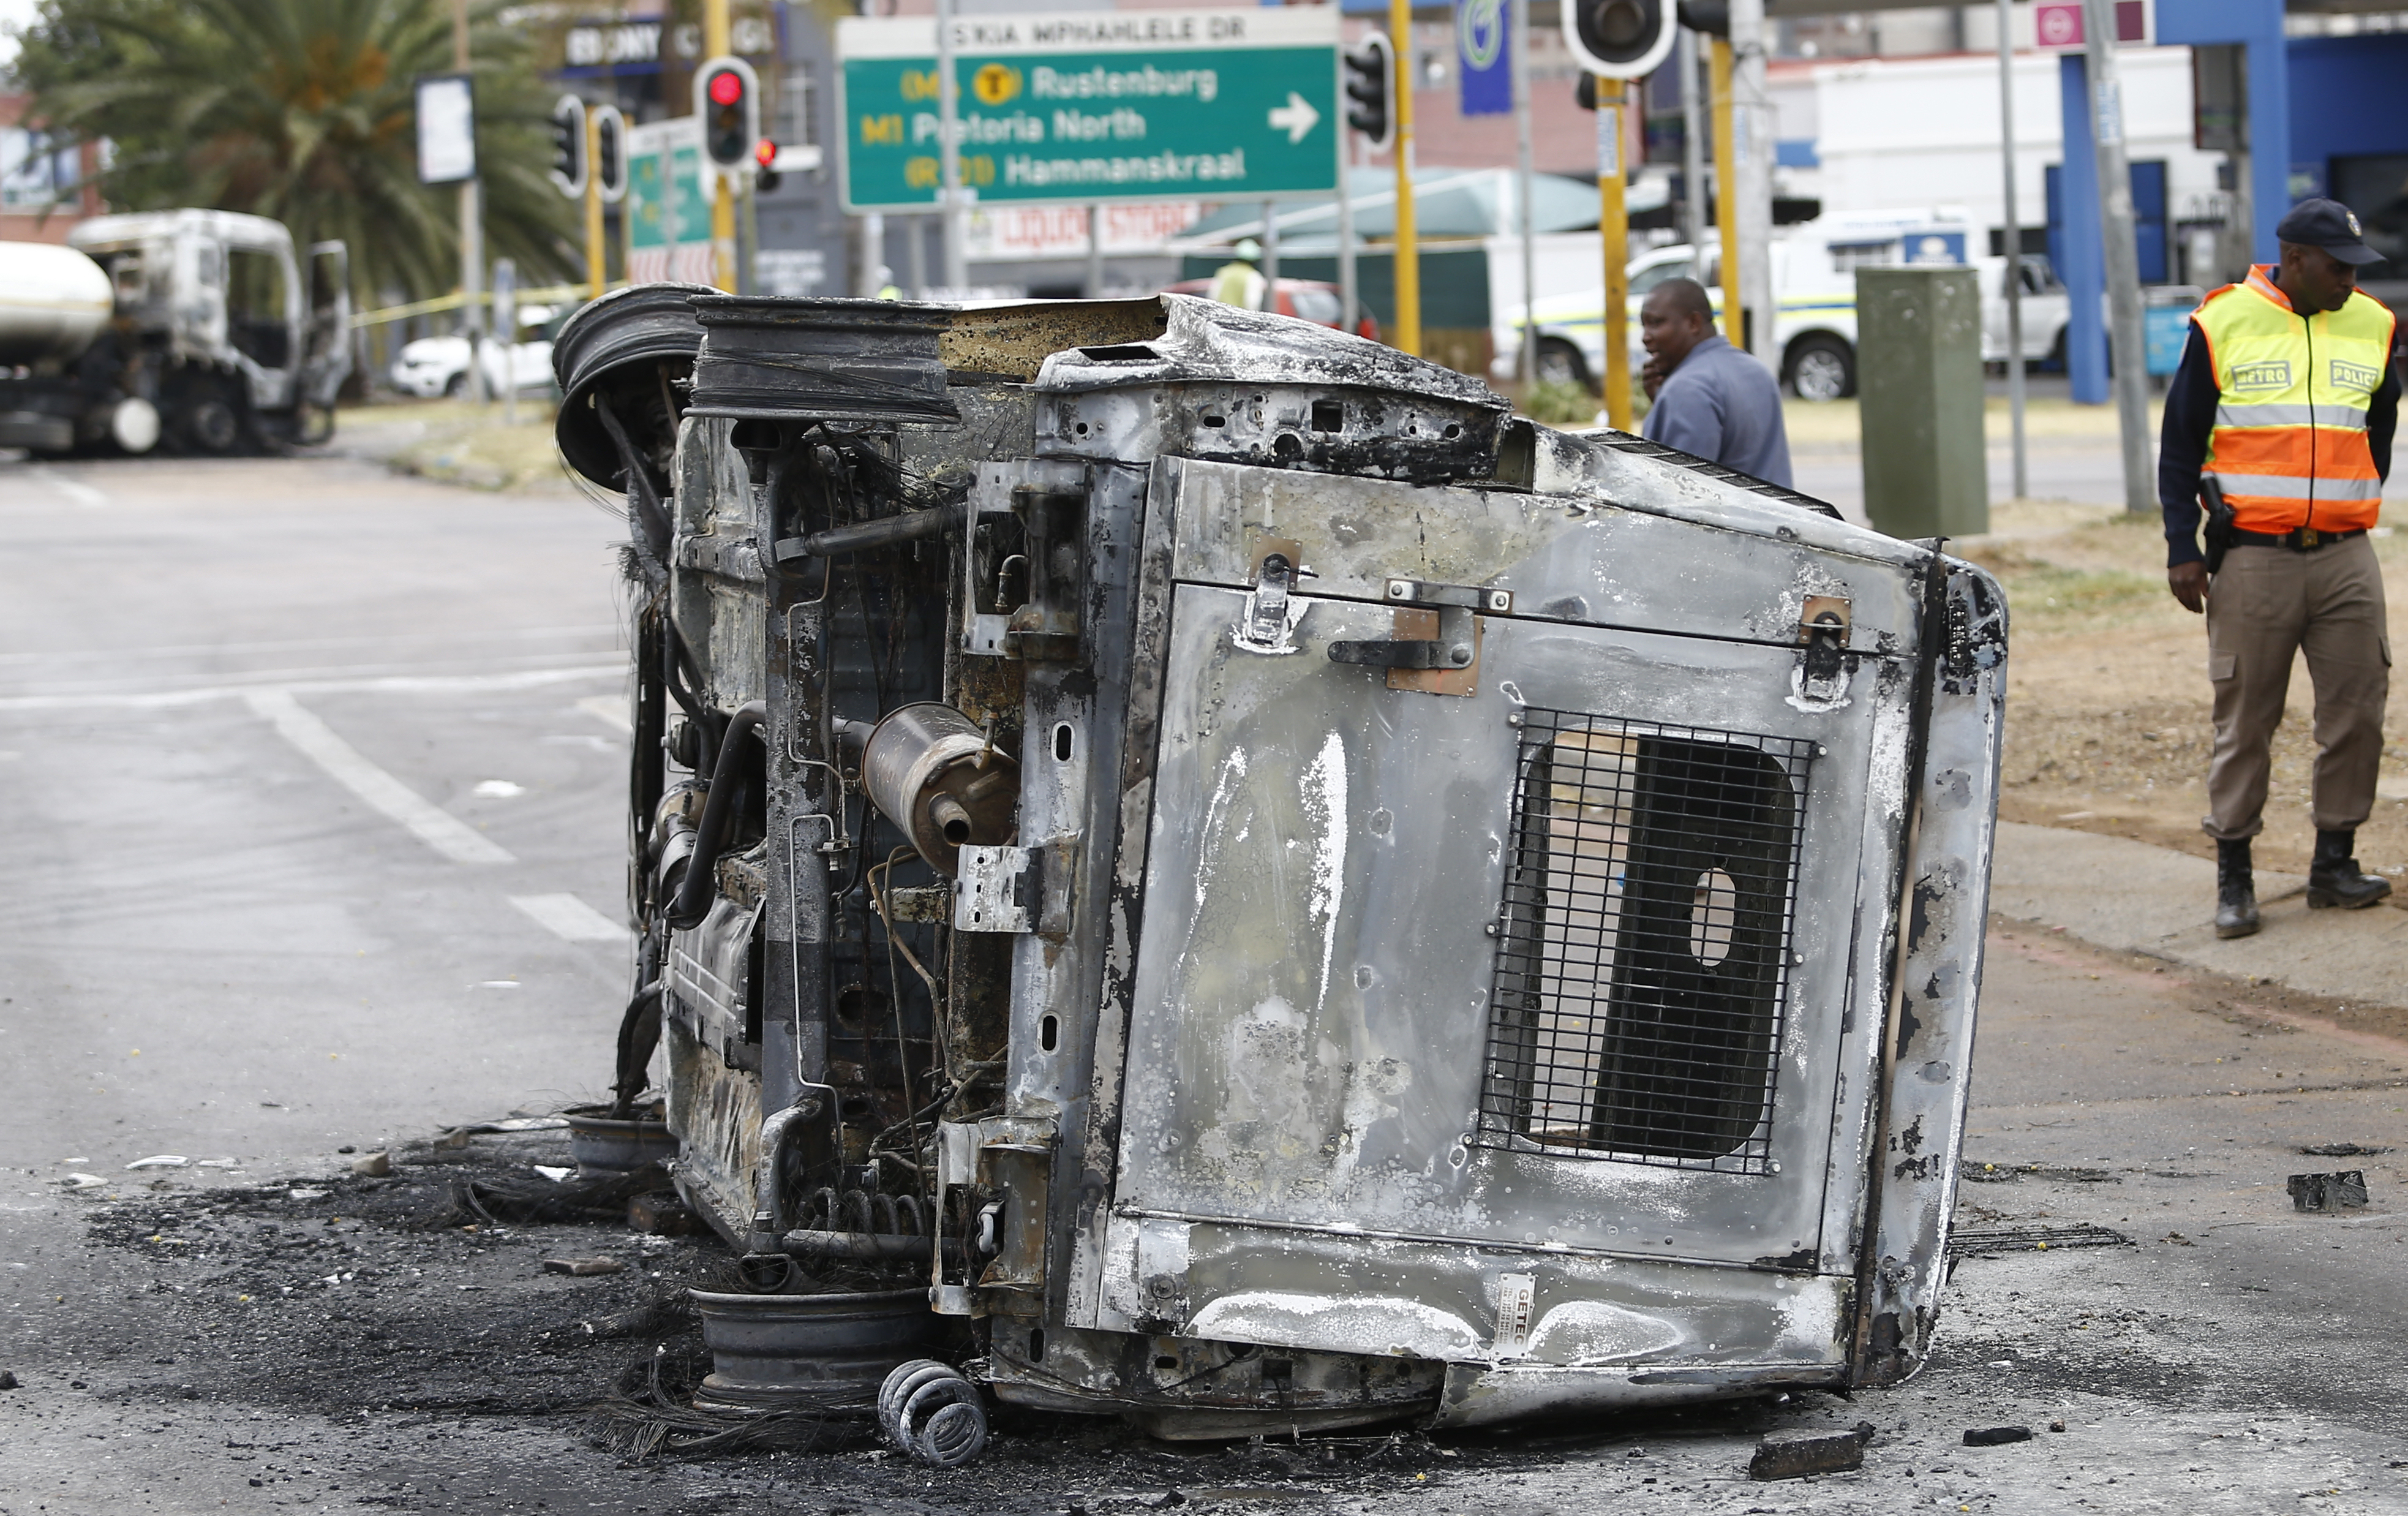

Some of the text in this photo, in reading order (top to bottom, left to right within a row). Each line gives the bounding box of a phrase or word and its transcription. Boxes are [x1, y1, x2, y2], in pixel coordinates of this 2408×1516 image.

[954, 14, 1249, 46] SKIA MPHAHLELE DR
[1032, 64, 1218, 103] Rustenburg
[860, 113, 904, 147] M1
[1053, 105, 1147, 143] North
[1004, 148, 1248, 186] Hammanskraal
[2333, 367, 2377, 386] POLIC
[1514, 1289, 1529, 1346] GETEC
